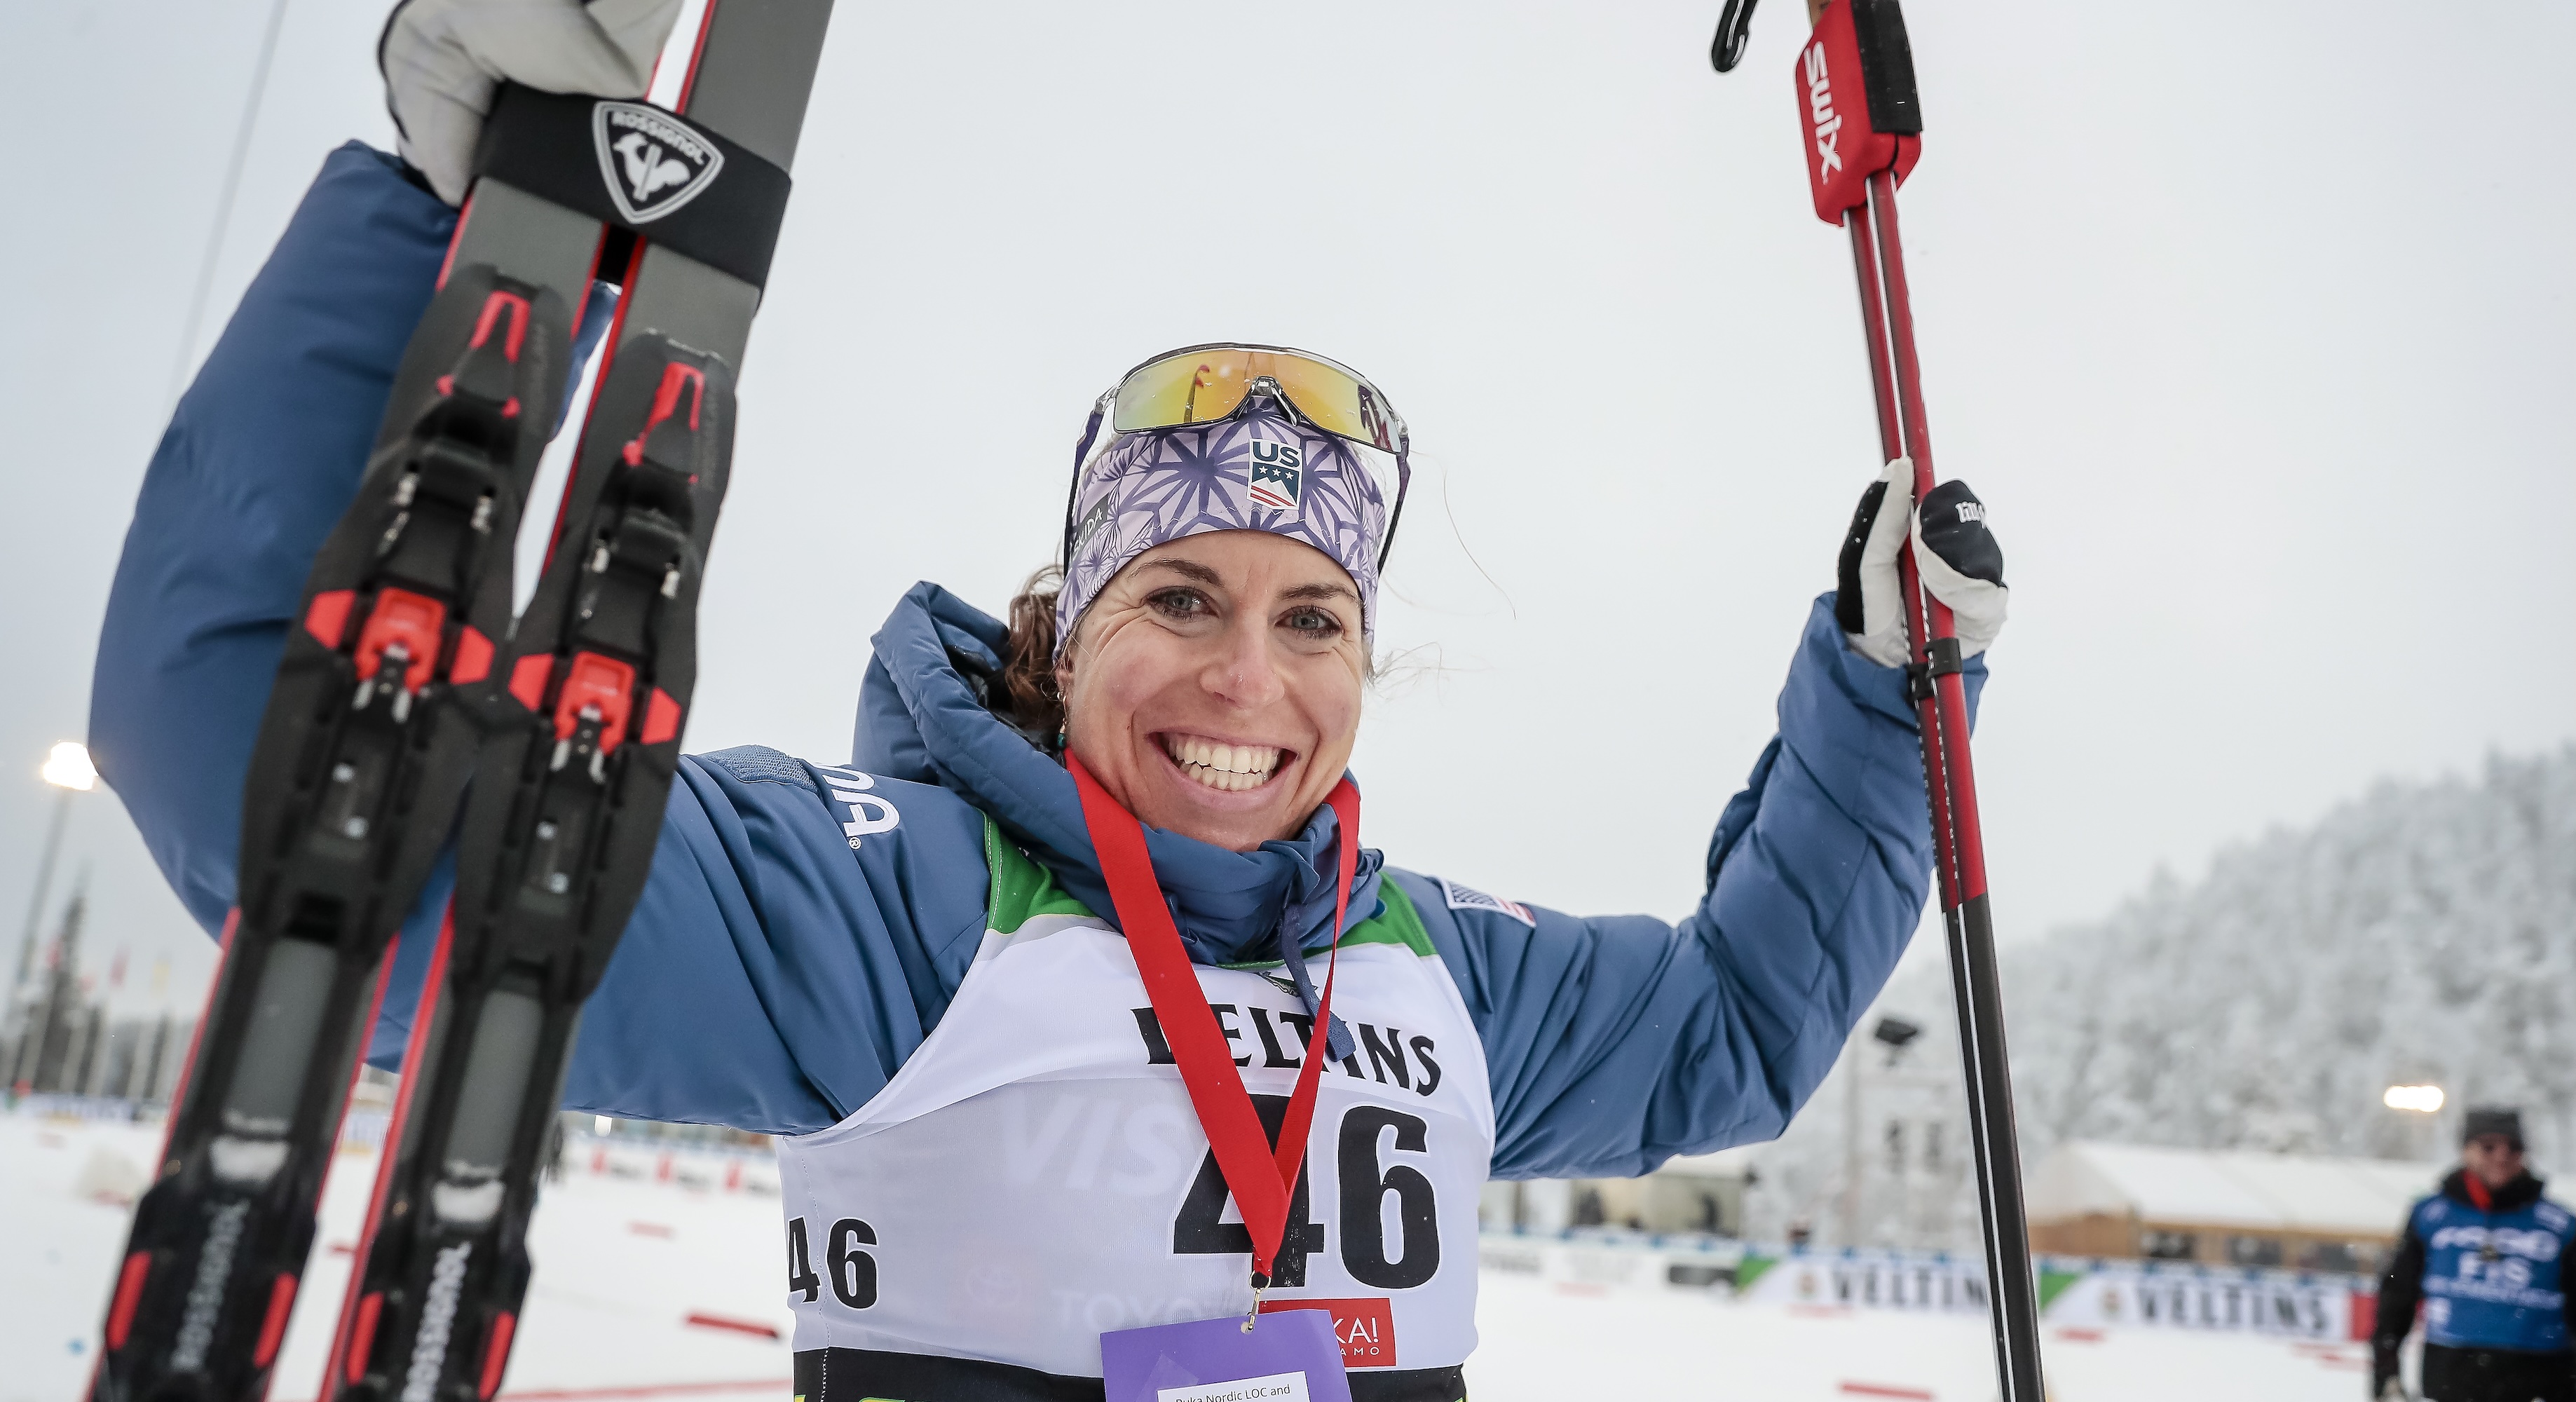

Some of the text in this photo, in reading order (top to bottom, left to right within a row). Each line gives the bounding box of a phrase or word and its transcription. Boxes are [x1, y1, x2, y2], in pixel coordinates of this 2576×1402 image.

[611, 111, 705, 166] ROSSIGNOL
[1252, 441, 1301, 468] US
[1003, 1092, 1193, 1196] VIS
[1173, 1094, 1440, 1288] 46
[789, 1217, 878, 1309] 46
[1832, 1264, 1988, 1307] VELTIN
[1334, 1317, 1379, 1344] KA!
[2137, 1280, 2329, 1338] VELTINS
[1206, 1391, 1243, 1402] Nordic
[1245, 1387, 1267, 1399] LOC
[1270, 1384, 1290, 1396] and
